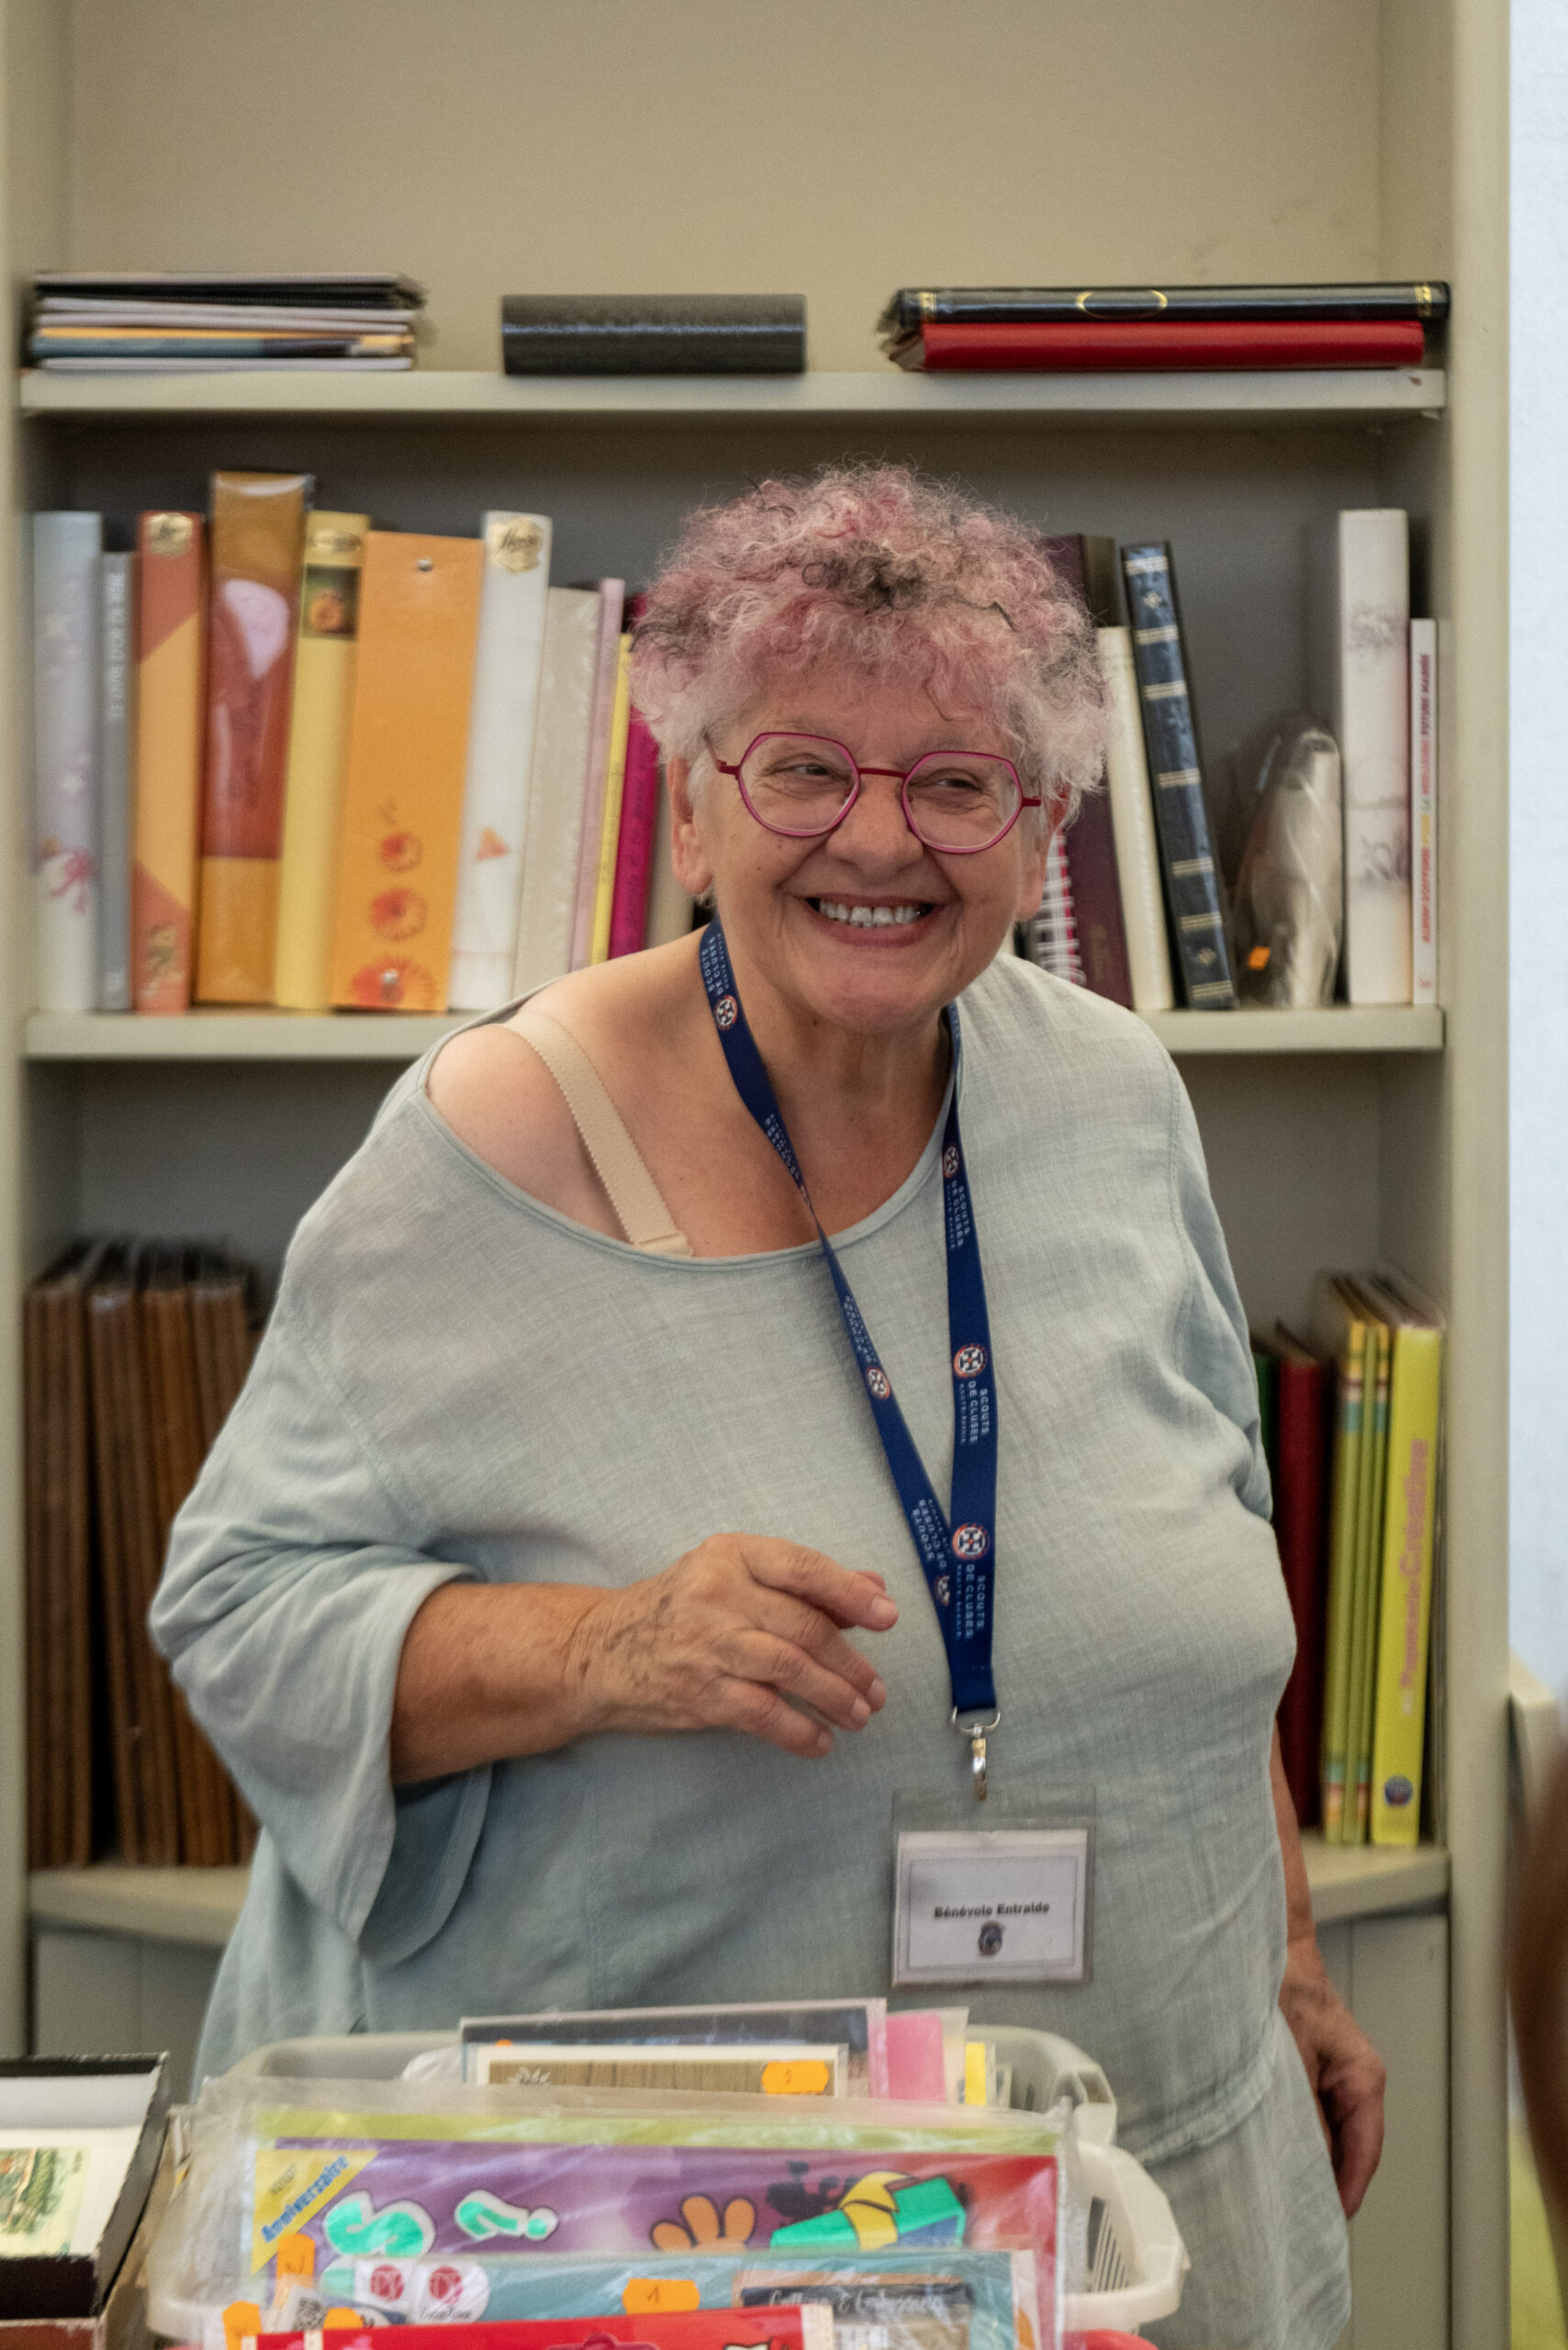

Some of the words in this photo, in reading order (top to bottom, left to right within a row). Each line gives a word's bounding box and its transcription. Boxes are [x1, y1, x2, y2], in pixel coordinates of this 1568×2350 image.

[701, 948, 715, 992] SCOUTS
[709, 936, 721, 979] CLUSES
[715, 979, 723, 995] DE
[951, 1181, 958, 1196] DE
[958, 1185, 970, 1235] SCOUTS
[953, 1198, 964, 1247] CLUSES
[969, 1381, 978, 1397] DE
[980, 1388, 990, 1434] SCOUTS
[969, 1399, 979, 1443] CLUSES
[912, 1508, 935, 1560] SCOUTS
[919, 1499, 941, 1549] CLUSES
[966, 1563, 975, 1582] DE
[965, 1584, 974, 1639] CLUSES
[976, 1574, 986, 1629] SCOUTS
[934, 1904, 992, 1919] Bénévole
[997, 1901, 1050, 1915] Entraide
